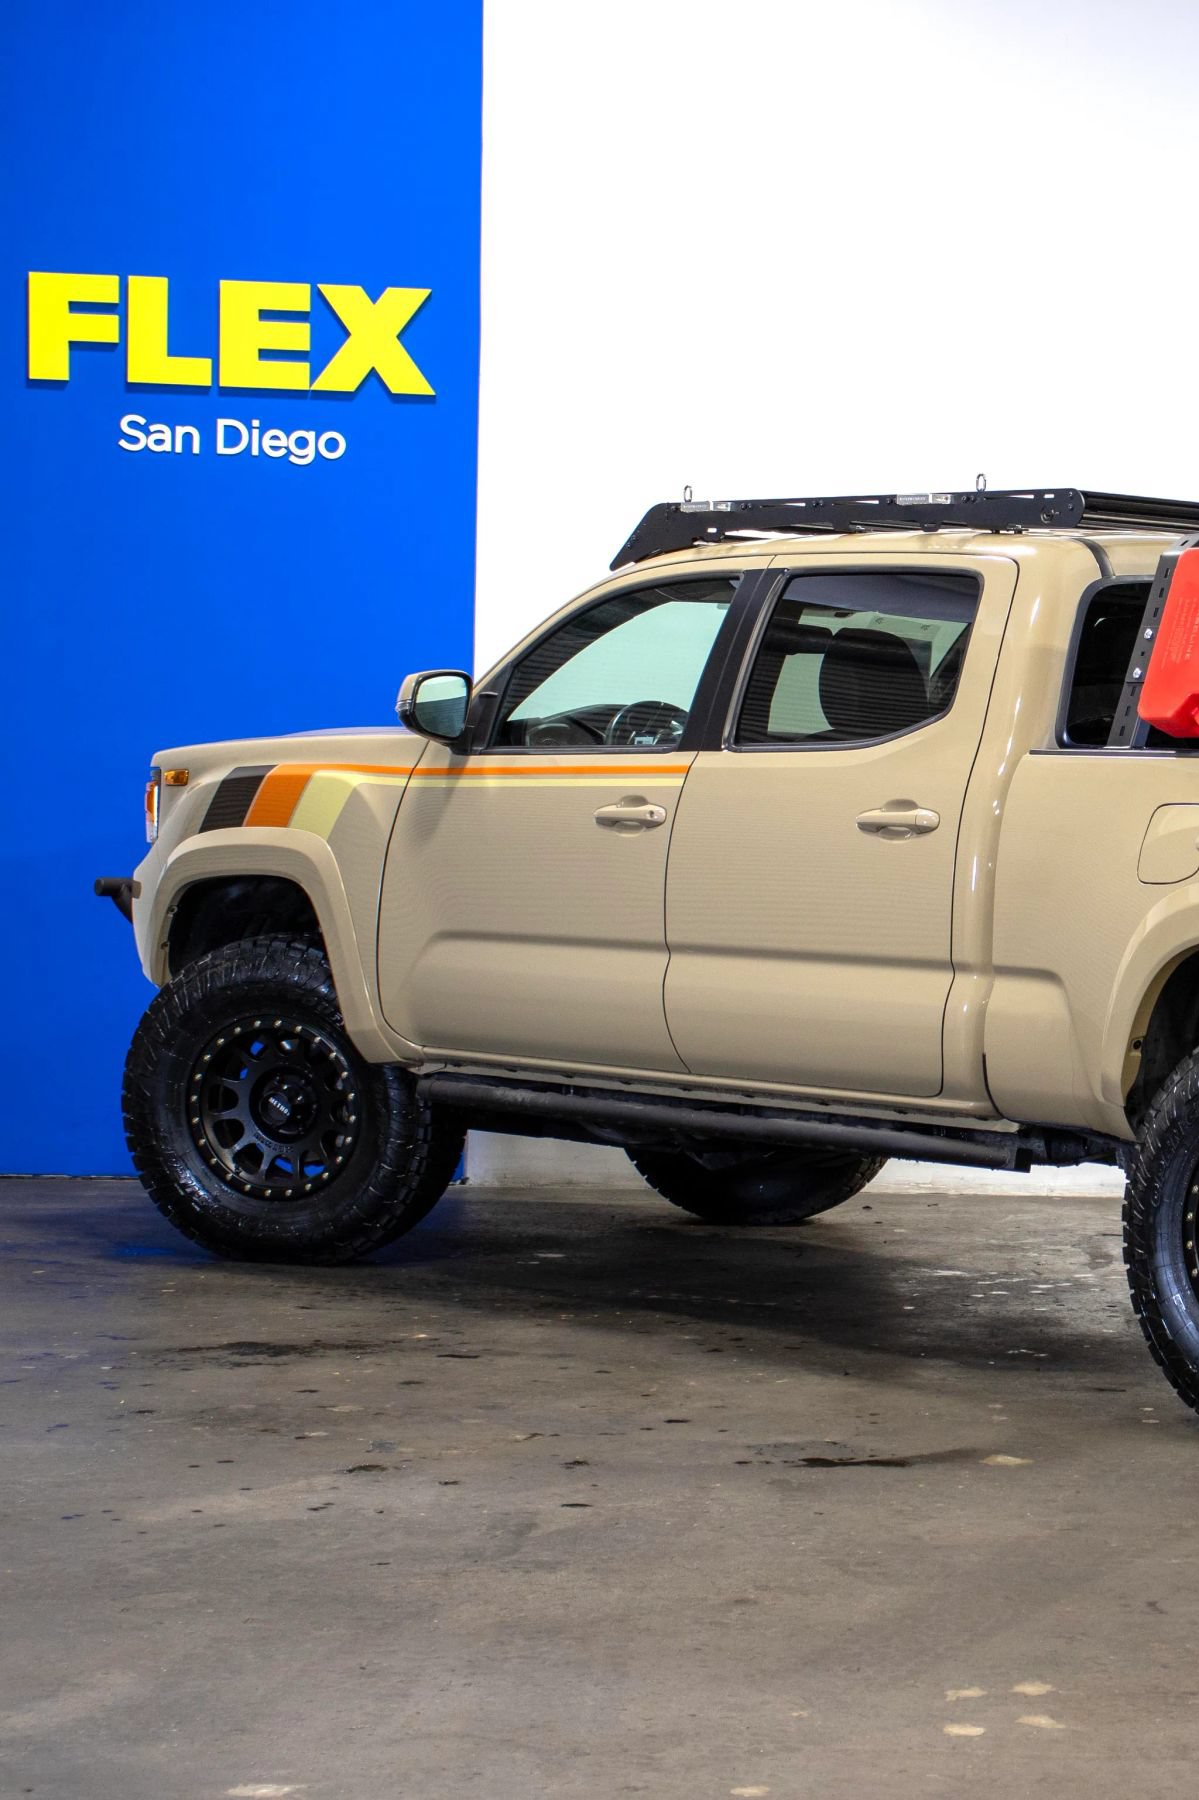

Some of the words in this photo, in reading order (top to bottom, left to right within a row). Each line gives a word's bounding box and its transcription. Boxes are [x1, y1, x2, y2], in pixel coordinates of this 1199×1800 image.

[28, 271, 436, 396] FLEX
[118, 414, 200, 455] San
[216, 418, 347, 466] Diego
